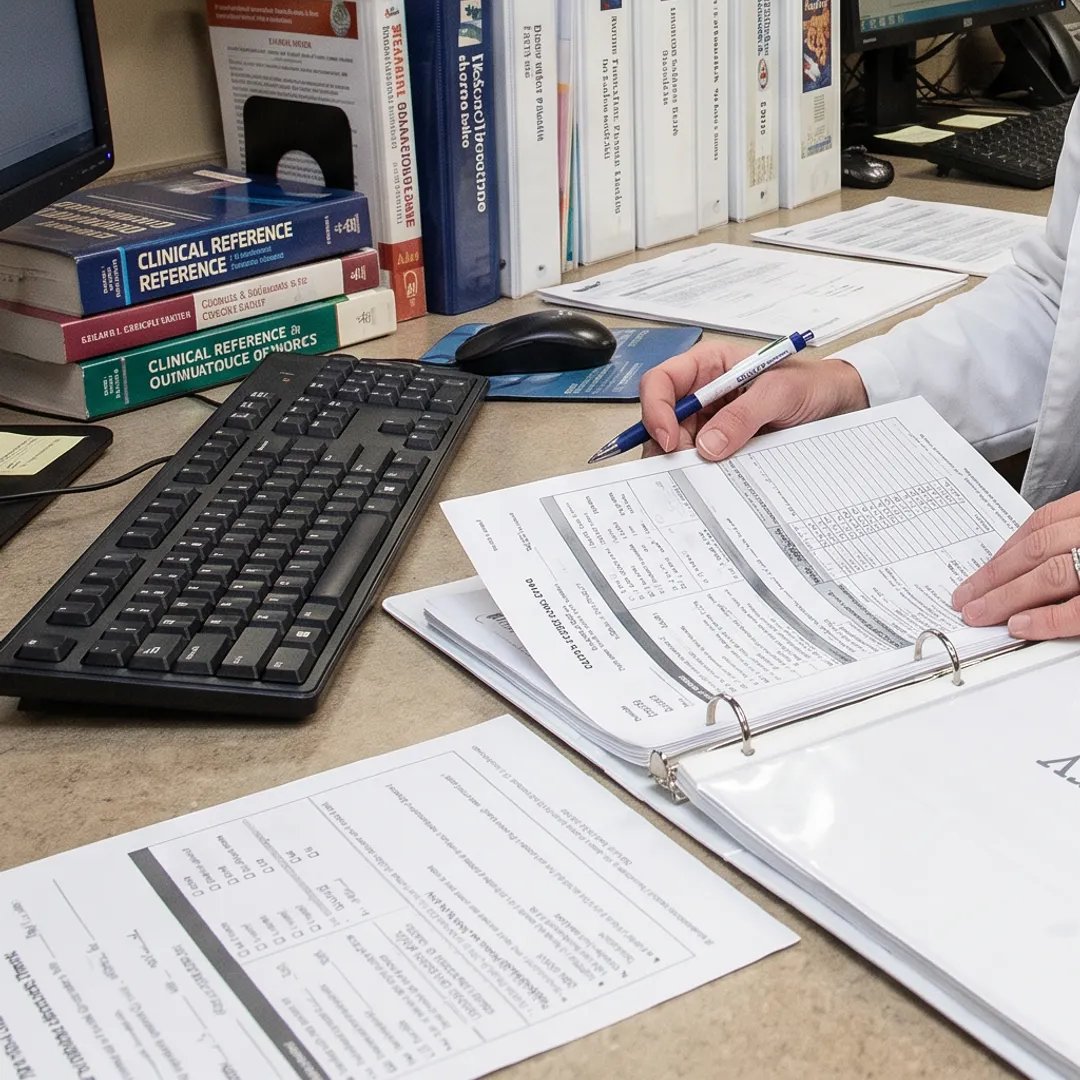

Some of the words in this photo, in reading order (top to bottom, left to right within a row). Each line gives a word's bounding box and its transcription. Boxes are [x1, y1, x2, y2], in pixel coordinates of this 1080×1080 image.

[137, 242, 210, 271] CLINICAL
[210, 220, 293, 256] REFERENCE
[139, 256, 228, 293] REFERENCE
[148, 347, 211, 374] CLINICAL
[214, 326, 287, 357] REFERENCE
[253, 347, 270, 362] OF
